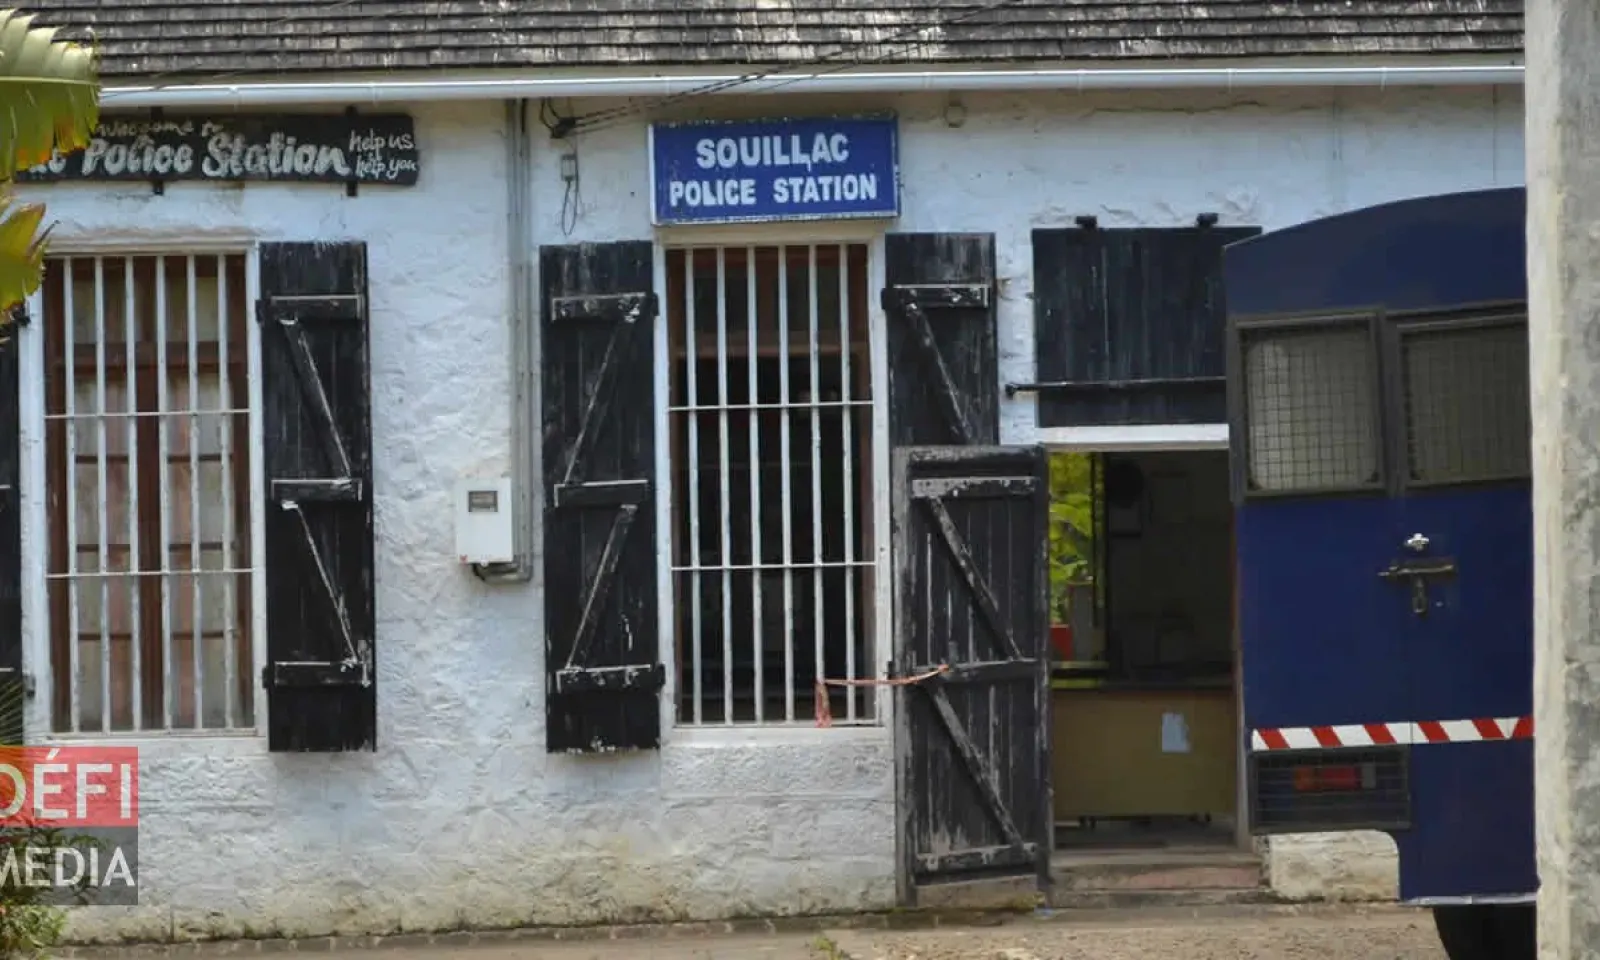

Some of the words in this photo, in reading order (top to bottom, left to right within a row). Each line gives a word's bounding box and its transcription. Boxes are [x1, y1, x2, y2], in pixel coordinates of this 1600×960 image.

[82, 134, 193, 176] Police
[201, 132, 350, 177] Station
[388, 133, 414, 150] us
[696, 132, 849, 169] SOUILLAC
[385, 158, 417, 180] you
[669, 179, 756, 206] POLICE
[773, 173, 877, 203] STATION
